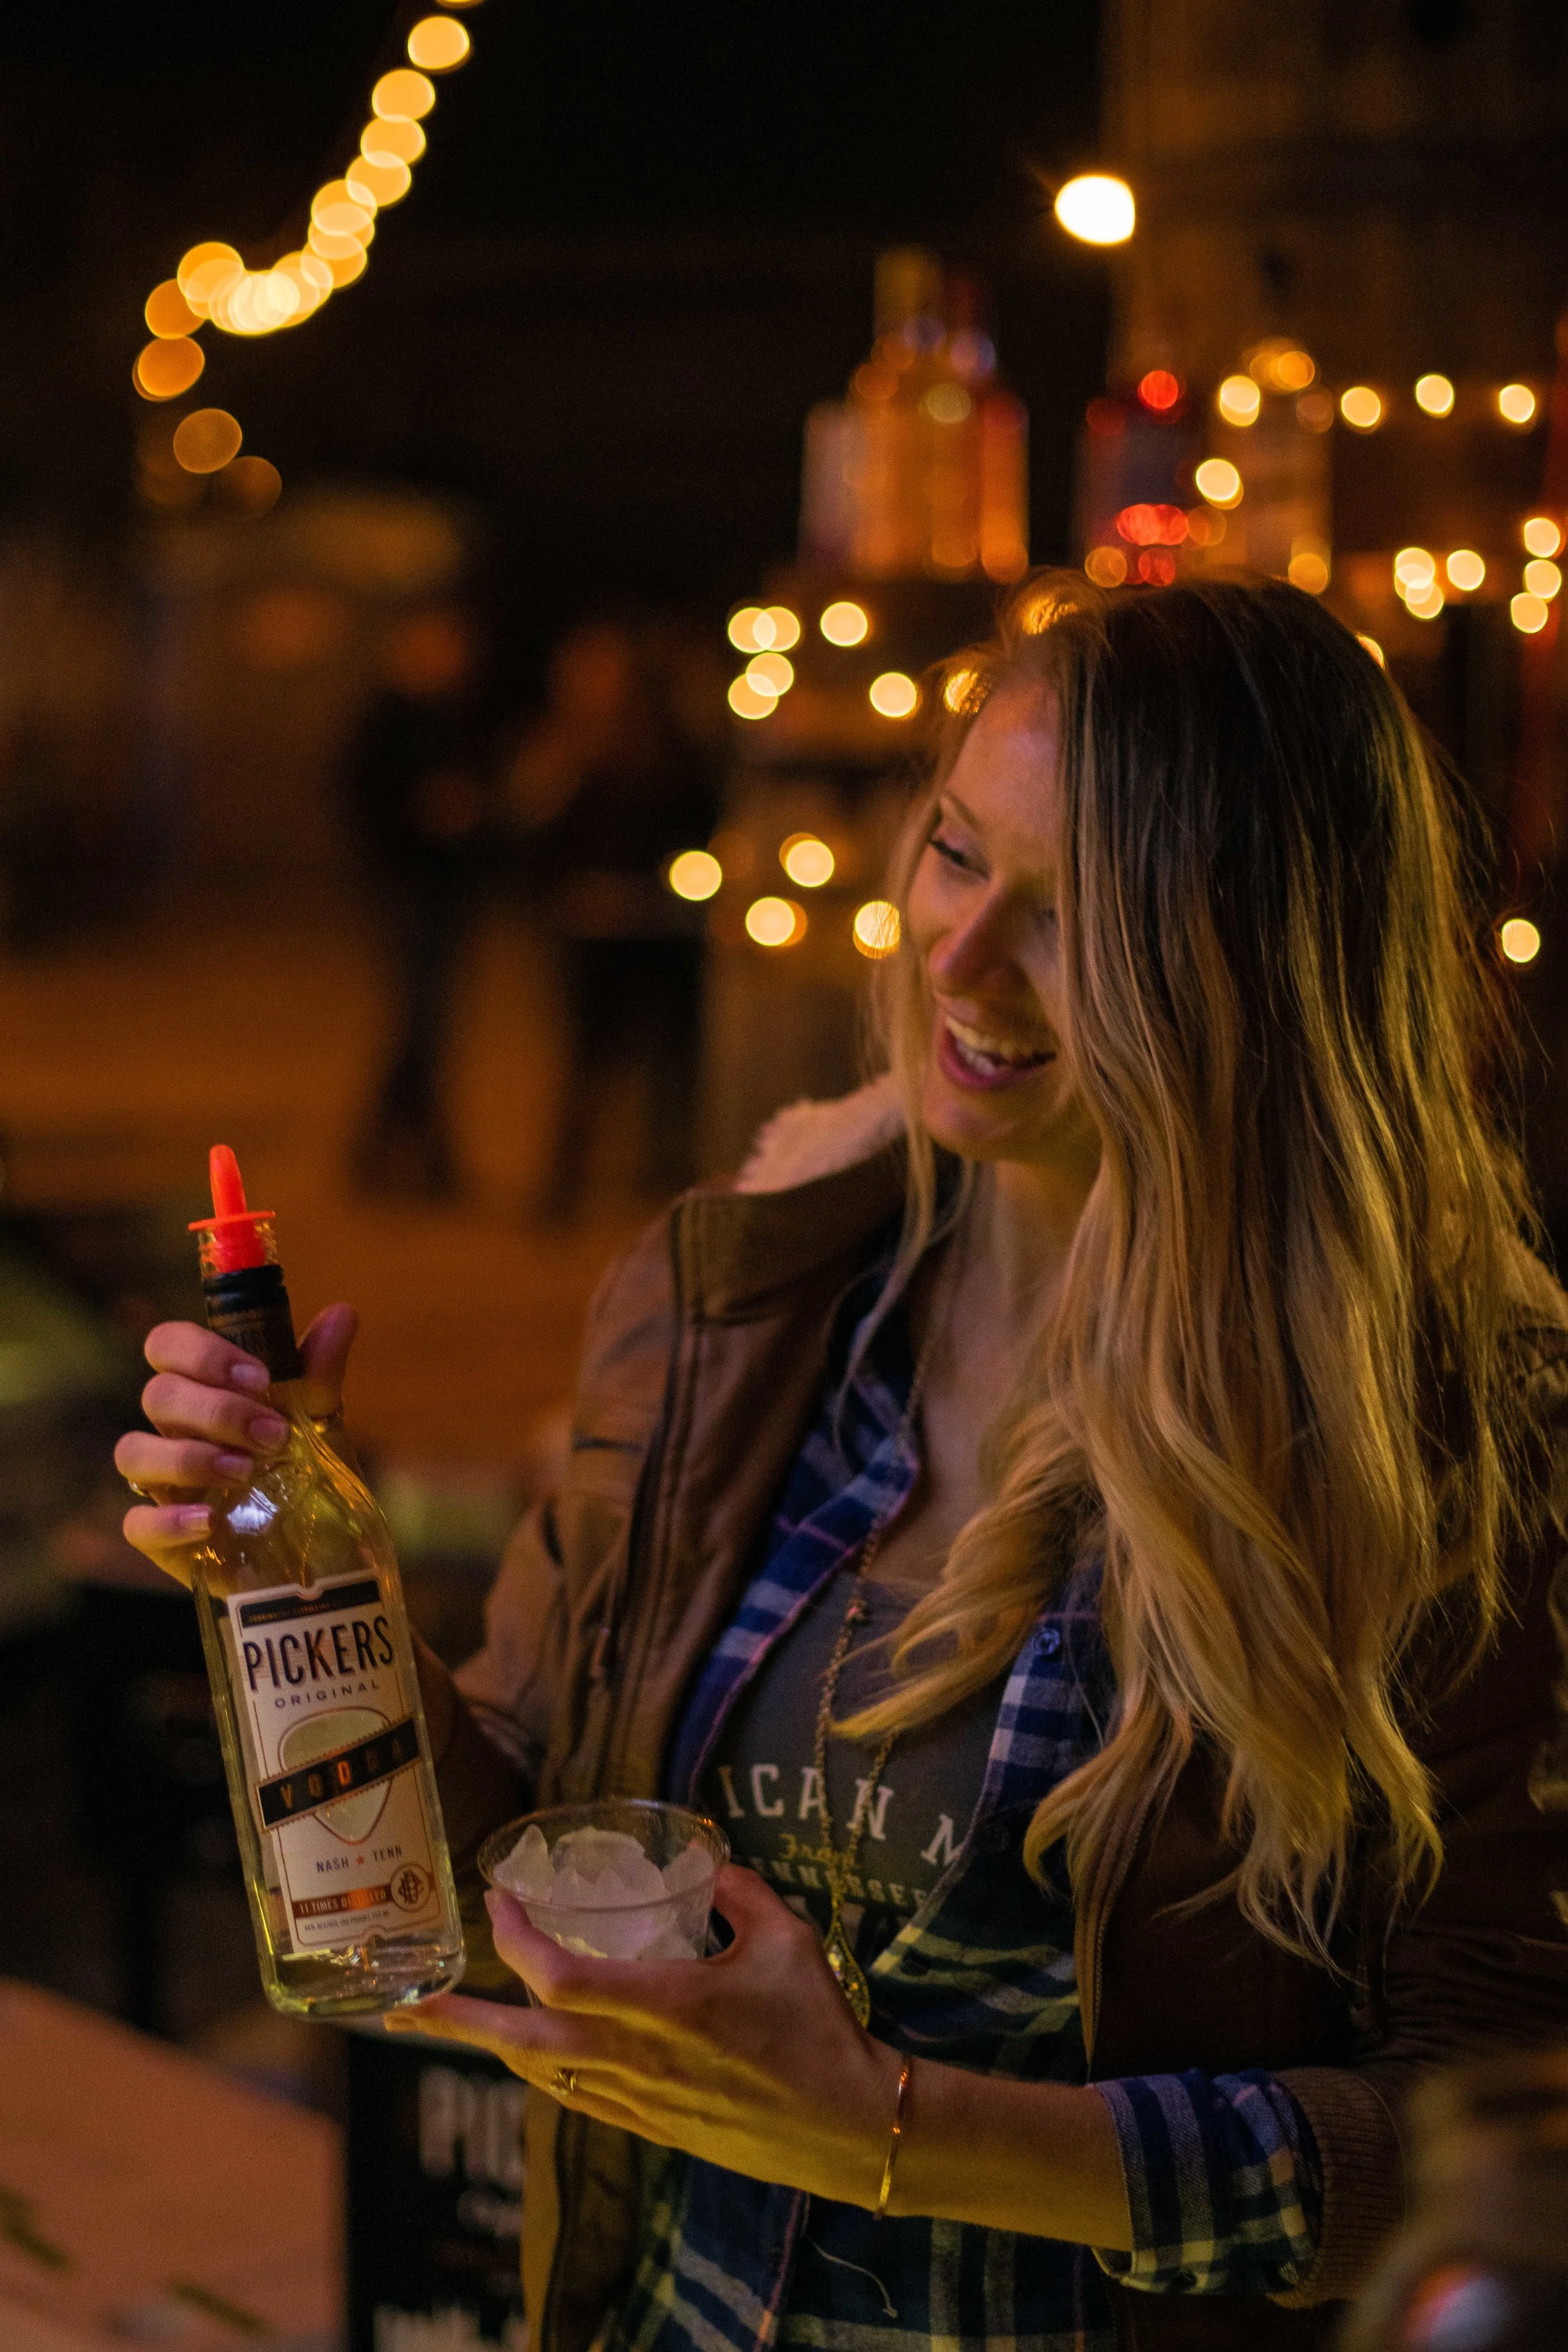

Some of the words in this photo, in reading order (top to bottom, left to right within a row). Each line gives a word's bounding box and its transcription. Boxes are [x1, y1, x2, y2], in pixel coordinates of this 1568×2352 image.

[243, 1616, 393, 1692] PICKERS
[275, 1680, 380, 1708] ORIGINAL
[280, 1737, 403, 1811] VODKA
[317, 1857, 349, 1873] NASH
[374, 1845, 402, 1862] TENN
[312, 1897, 340, 1912] TIMES
